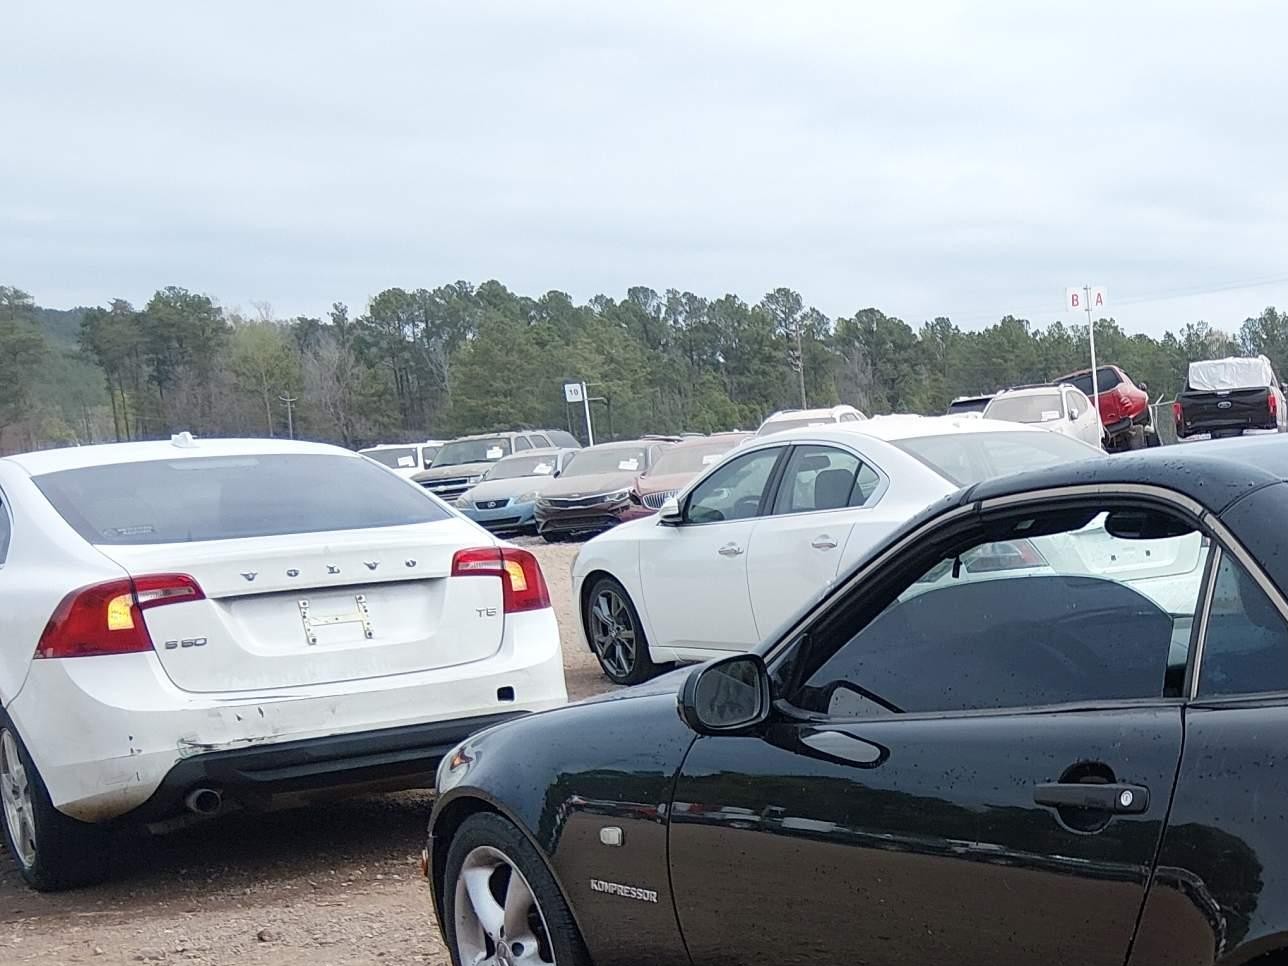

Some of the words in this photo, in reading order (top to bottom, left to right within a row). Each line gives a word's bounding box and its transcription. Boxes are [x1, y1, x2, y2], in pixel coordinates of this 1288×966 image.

[1071, 293, 1079, 307] B
[1095, 292, 1103, 306] A
[240, 559, 417, 582] VOLVO
[590, 878, 658, 904] KOMPRESSOR
